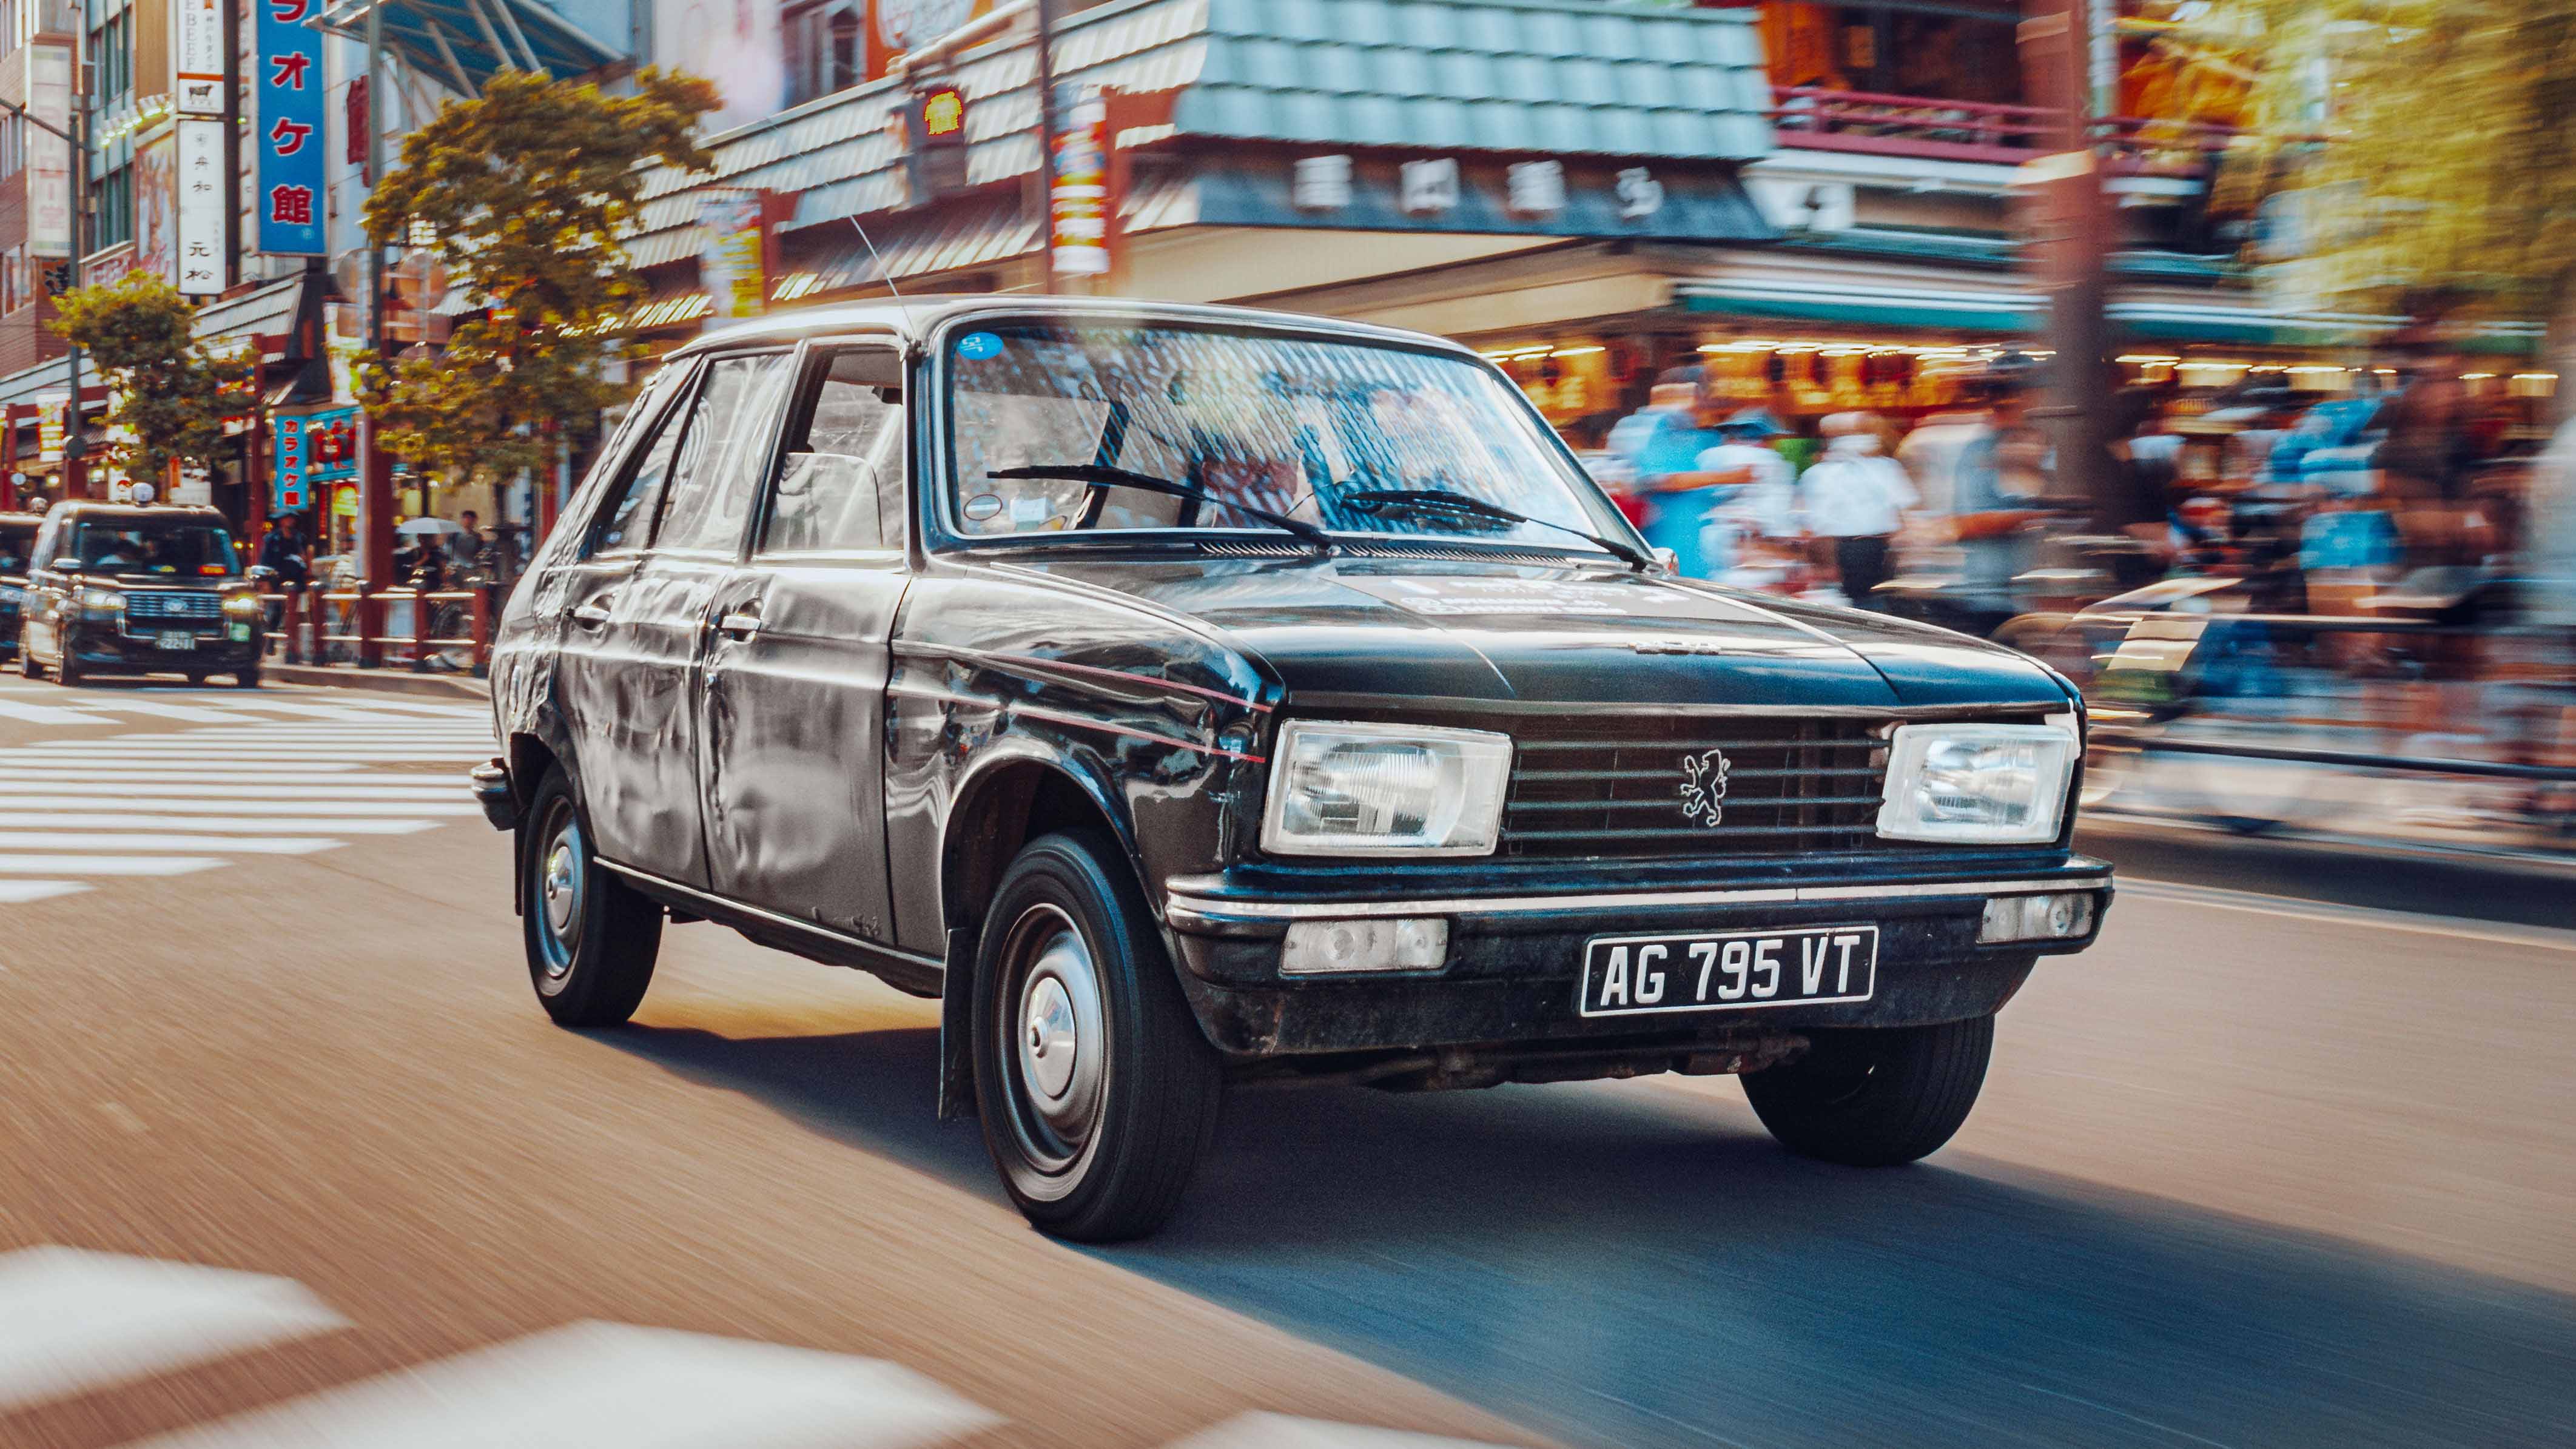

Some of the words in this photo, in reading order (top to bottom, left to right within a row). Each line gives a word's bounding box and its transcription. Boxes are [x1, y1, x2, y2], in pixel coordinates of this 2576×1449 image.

[271, 0, 313, 225] ラオケ館
[1600, 944, 1668, 1006] AG
[1689, 939, 1783, 1001] 795
[1802, 935, 1861, 995] VT
